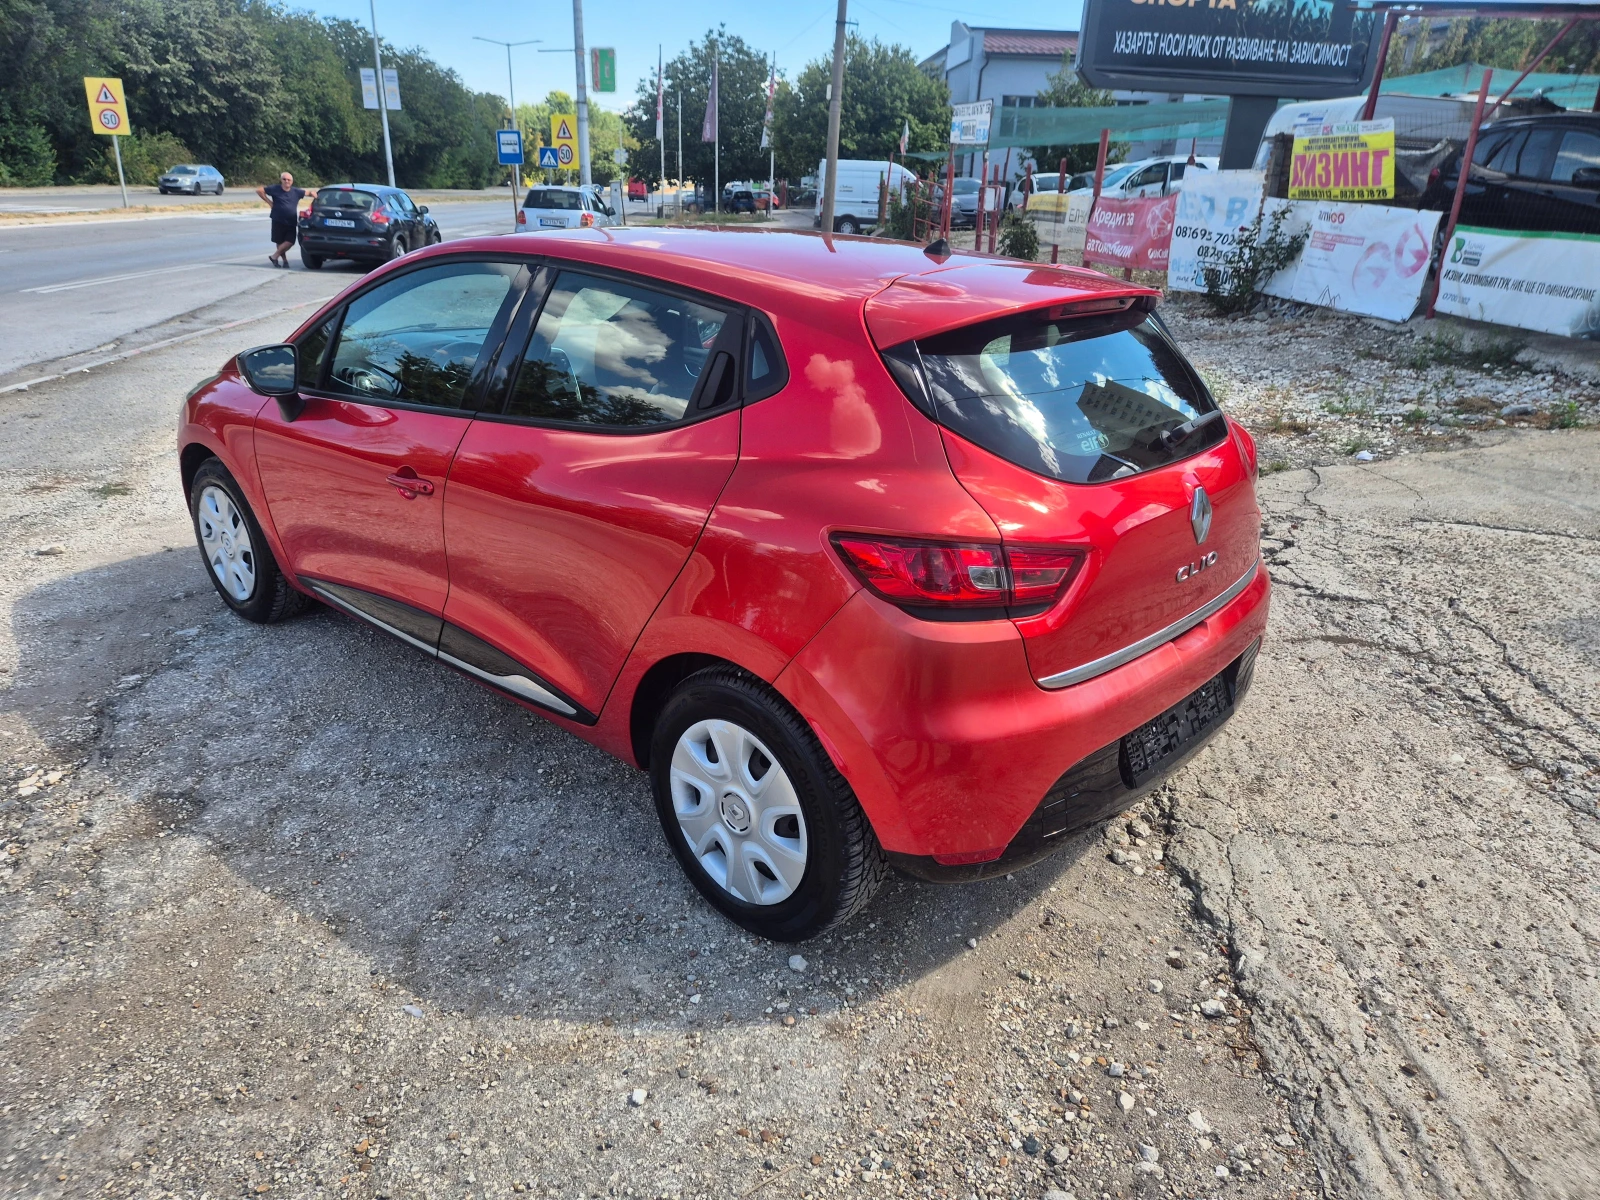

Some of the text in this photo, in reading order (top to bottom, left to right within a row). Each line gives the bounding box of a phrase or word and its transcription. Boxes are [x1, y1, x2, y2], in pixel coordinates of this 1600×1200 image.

[1113, 31, 1351, 67] ХАЗАРТЪТ НОСИ РИСК ОТ РАЗВИВАНЕ НА ЗАВИСИМОСТ
[103, 113, 117, 125] 50
[560, 148, 571, 160] 50
[1291, 149, 1390, 189] ЛИЗИНГ
[1376, 188, 1388, 198] 28
[1093, 207, 1135, 229] Кредит за
[1086, 238, 1134, 258] автомобили
[1461, 272, 1499, 288] АВТОМОБИЛ
[1510, 278, 1524, 292] НИЕ
[1524, 280, 1537, 296] ЩЕ
[1536, 282, 1545, 295] ГО
[1545, 283, 1597, 302] ФИНАНСИРАМЕ
[1081, 436, 1099, 452] elf
[1176, 550, 1218, 583] CLIO
